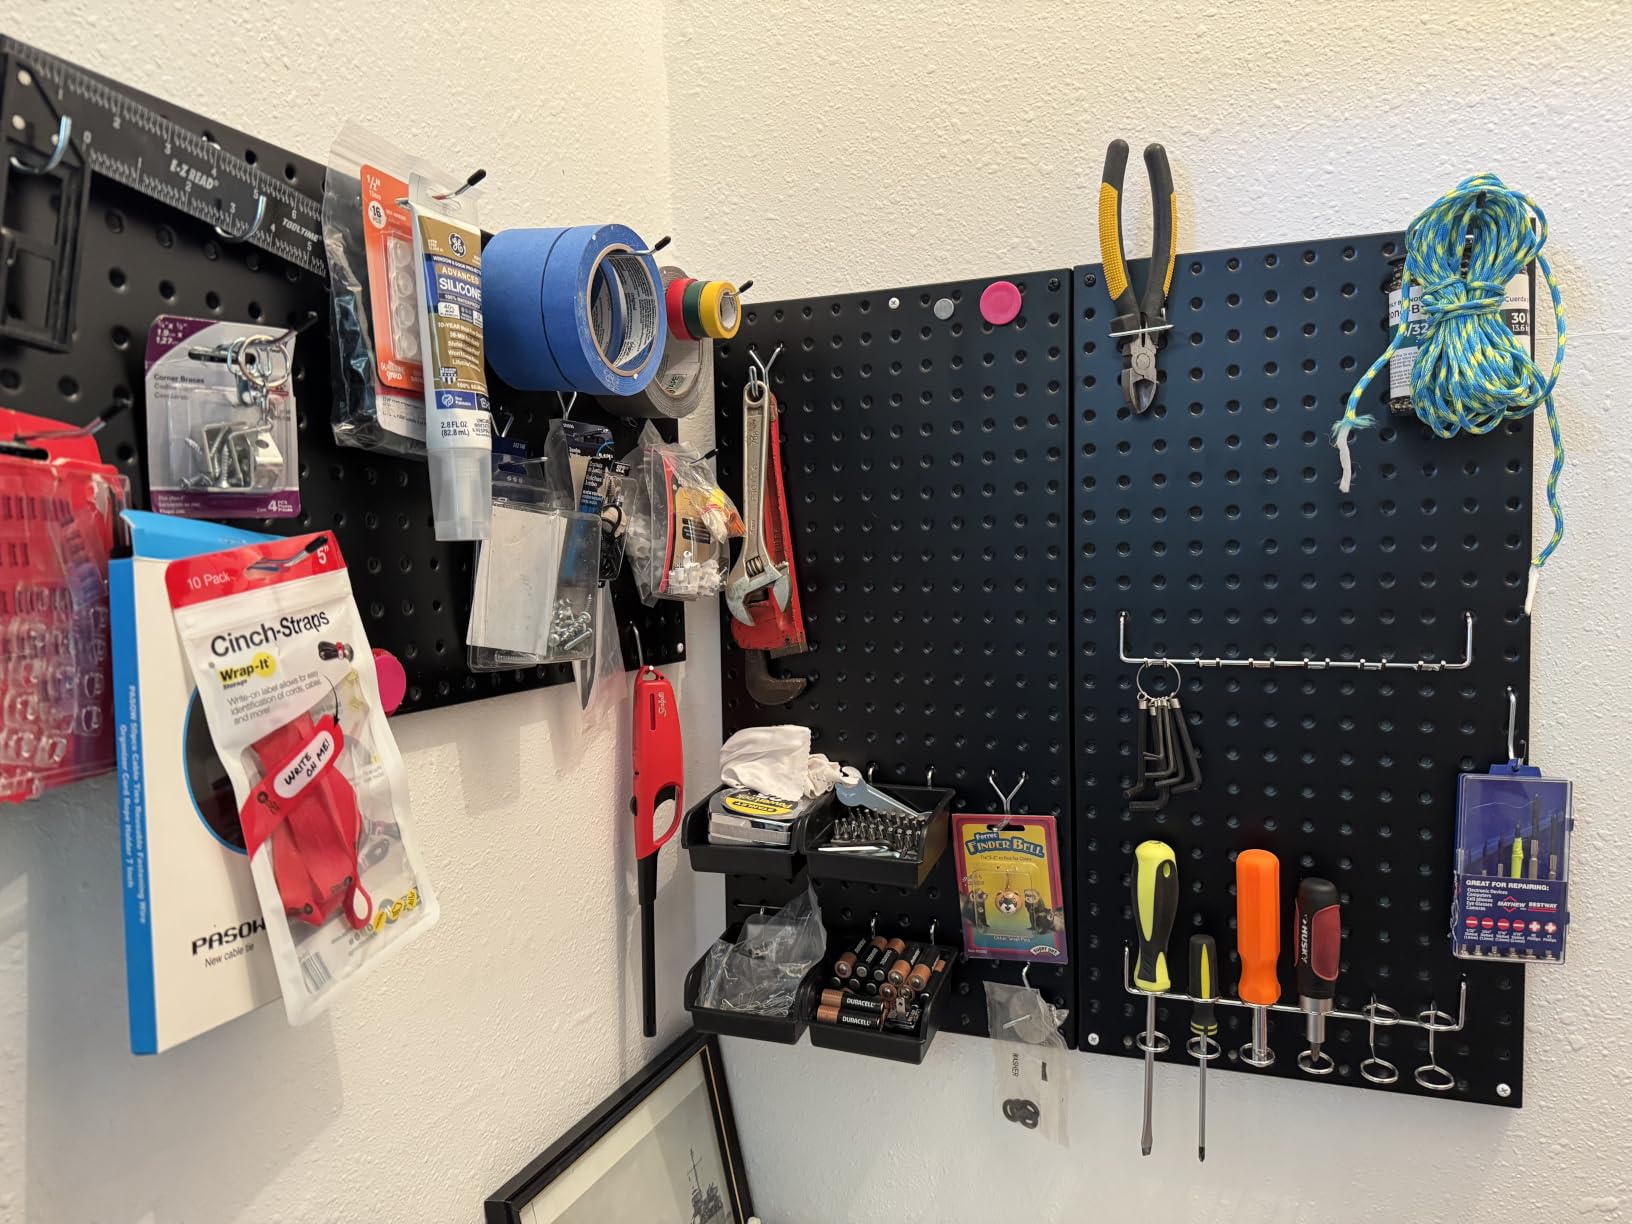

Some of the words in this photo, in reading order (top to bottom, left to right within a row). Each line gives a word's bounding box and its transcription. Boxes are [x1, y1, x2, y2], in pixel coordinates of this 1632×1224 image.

[113, 116, 121, 129] 2
[164, 143, 172, 155] 3
[185, 181, 192, 192] 2
[229, 202, 236, 213] 3
[306, 241, 313, 251] 5
[372, 205, 382, 217] 16
[282, 217, 319, 242] TOOLTIME
[441, 266, 480, 285] ADVANCED
[439, 277, 482, 301] SILICONE
[438, 321, 460, 330] 10-YEAR
[1511, 312, 1526, 324] 30
[1512, 324, 1525, 332] 13.6
[441, 428, 457, 438] (82.8
[268, 500, 278, 512] 4
[316, 544, 329, 565] 5"
[187, 577, 202, 590] 10
[203, 571, 231, 588] Pack
[210, 610, 330, 658] Cinch-Straps
[219, 657, 270, 683] Wrap-It
[226, 690, 260, 706] Write-on
[261, 682, 278, 695] label
[279, 677, 299, 689] allows
[128, 685, 137, 720] PASOW
[230, 694, 277, 715] identification
[277, 692, 285, 700] of
[234, 714, 249, 724] and
[305, 761, 318, 777] ON
[316, 737, 331, 762] ME!
[283, 752, 312, 786] WRITE
[119, 724, 128, 770] Organizer
[124, 823, 132, 857] Holder
[734, 801, 776, 812] STANLEY
[135, 805, 143, 850] Reusable
[975, 832, 998, 840] Ferret
[967, 840, 1011, 854] FINDER
[1012, 837, 1045, 856] BELL
[136, 851, 145, 899] Fastening
[1466, 880, 1490, 888] GREAT
[1508, 882, 1550, 891] REPAIRING:
[1528, 901, 1558, 909] BESTWAY
[192, 916, 267, 956] PASOW
[1301, 925, 1309, 965] HUSKY
[205, 954, 223, 968] New
[223, 947, 244, 961] cable
[846, 997, 876, 1009] DURACELL
[842, 1015, 872, 1027] DURACELL
[1011, 1053, 1019, 1078] WASHER
